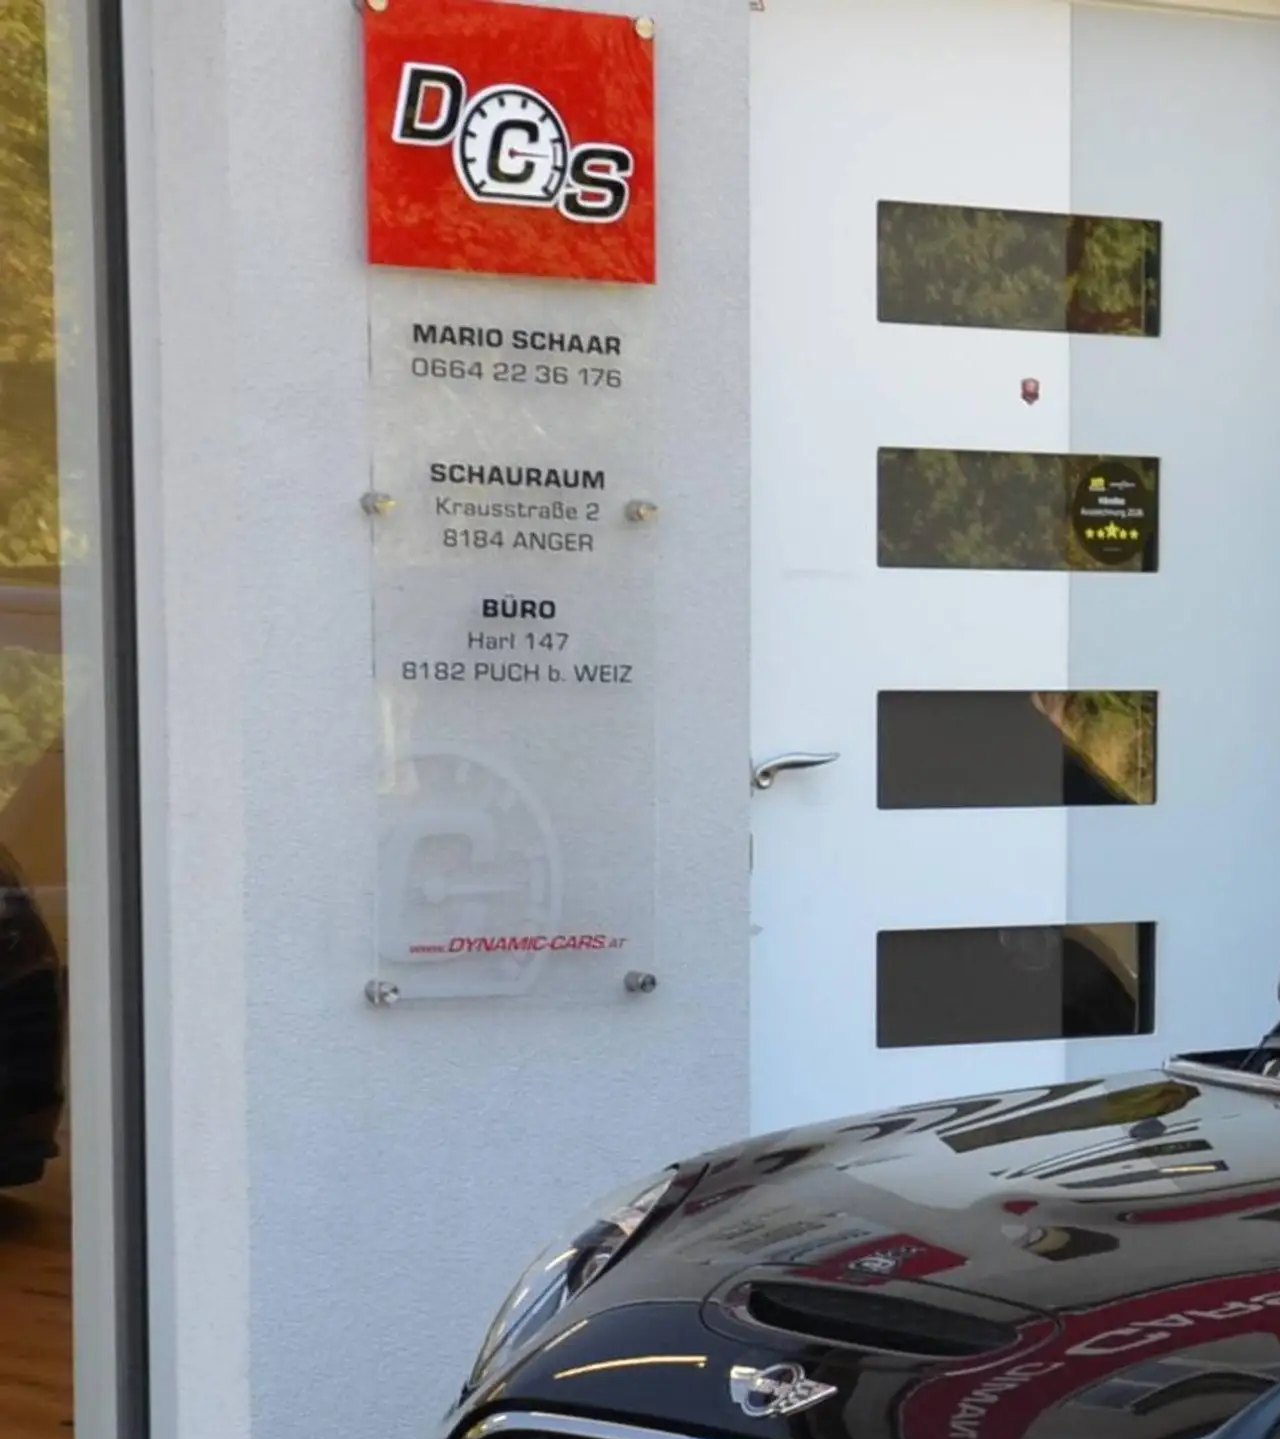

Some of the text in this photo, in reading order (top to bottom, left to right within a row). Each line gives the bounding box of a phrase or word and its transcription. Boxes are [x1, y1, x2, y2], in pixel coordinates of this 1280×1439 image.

[392, 61, 634, 223] DCS
[412, 323, 622, 356] MARIO SCHAAR
[411, 356, 622, 389] 0664 22 36 176
[429, 462, 606, 490] SCHAURAUM
[435, 496, 600, 521] Krausstraße 2
[442, 528, 594, 552] 8184 ANGER
[481, 593, 557, 620] BÜRO
[524, 631, 570, 652] 147
[401, 661, 633, 684] 8182 PUCH b. WEIZ
